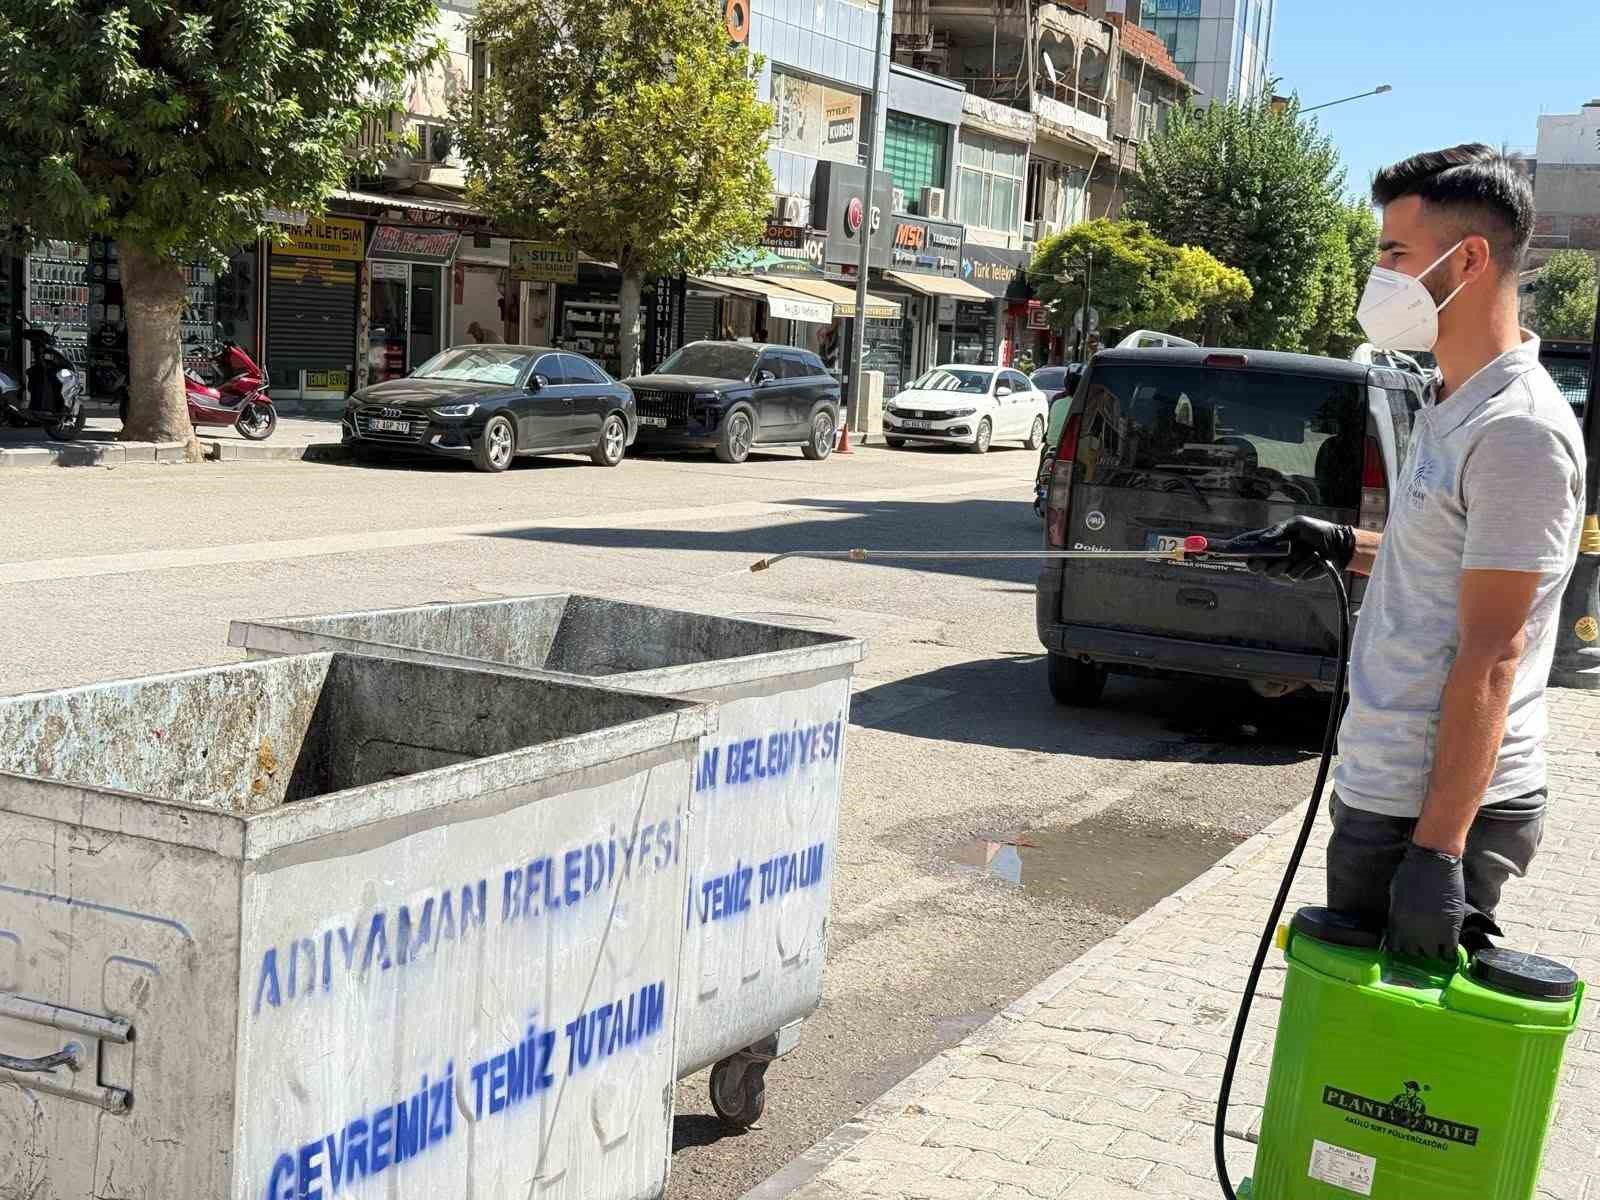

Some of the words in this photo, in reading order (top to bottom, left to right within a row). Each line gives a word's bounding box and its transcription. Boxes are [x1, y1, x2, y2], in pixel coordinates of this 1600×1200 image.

[830, 123, 853, 140] KURSU
[803, 239, 824, 266] KOÇ
[973, 260, 991, 280] Türk
[701, 858, 753, 925] TEMİZ
[759, 842, 825, 904] TUTALIM
[470, 1022, 556, 1122] TEMİZ
[565, 980, 666, 1078] TUTALIM
[1326, 1089, 1388, 1119] PLANT
[1423, 1118, 1476, 1143] MATE
